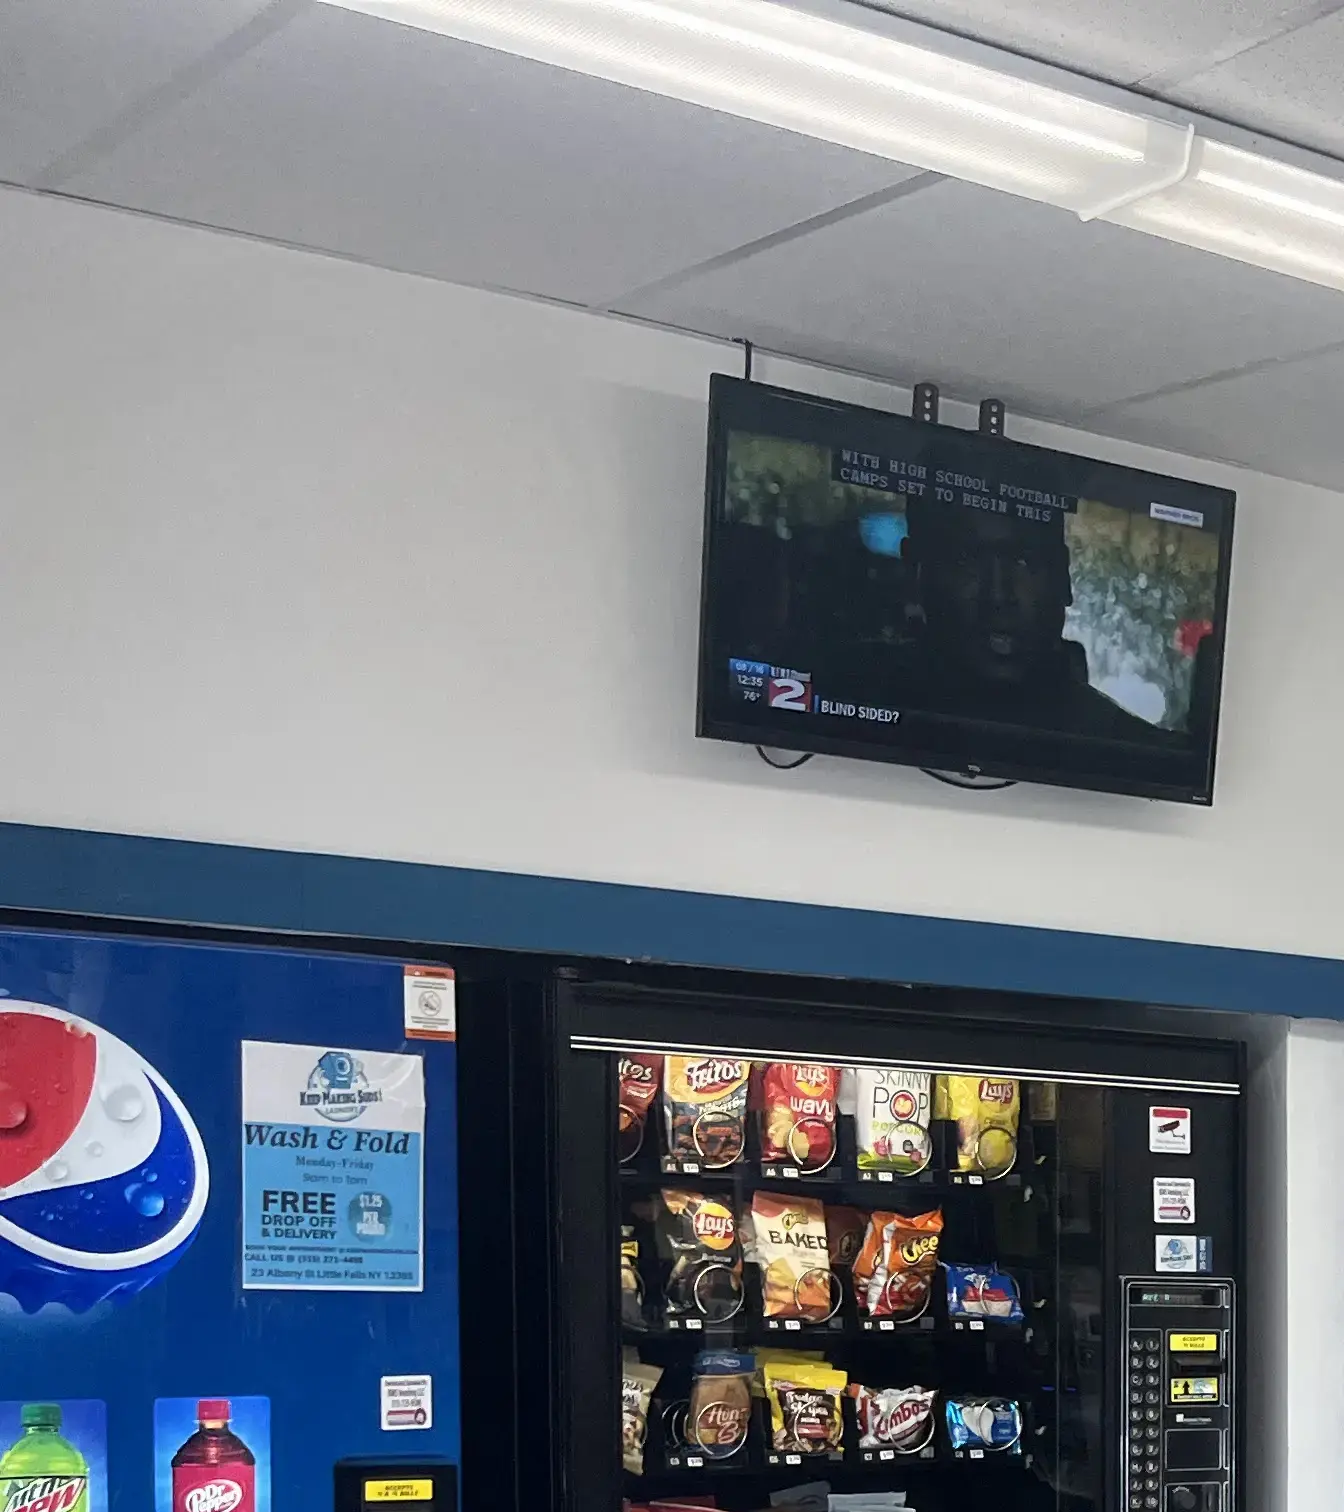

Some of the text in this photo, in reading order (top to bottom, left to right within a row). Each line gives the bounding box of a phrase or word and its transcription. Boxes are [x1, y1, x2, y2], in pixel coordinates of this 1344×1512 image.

[841, 450, 1069, 509] WITH HIGH SCHOOL FOOTBALL
[840, 468, 1051, 522] CAMPS SET TO BEGIN THIS
[737, 674, 763, 687] 12:35
[771, 678, 807, 712] 2
[820, 700, 900, 723] BLIND SIDED?
[686, 1059, 742, 1089] Fritos
[873, 1070, 931, 1091] SKINNY
[789, 1095, 834, 1122] wavy
[872, 1086, 930, 1124] POP
[244, 1123, 410, 1155] Wash & Fold
[262, 1189, 336, 1215] FREE
[261, 1214, 337, 1228] DROP OFF
[274, 1228, 338, 1240] DELIVERY
[768, 1230, 829, 1250] BAKED
[244, 1253, 267, 1262] CALL
[270, 1254, 283, 1263] US
[902, 1235, 939, 1263] Chee
[368, 1270, 382, 1280] NY
[204, 1484, 226, 1499] Dr
